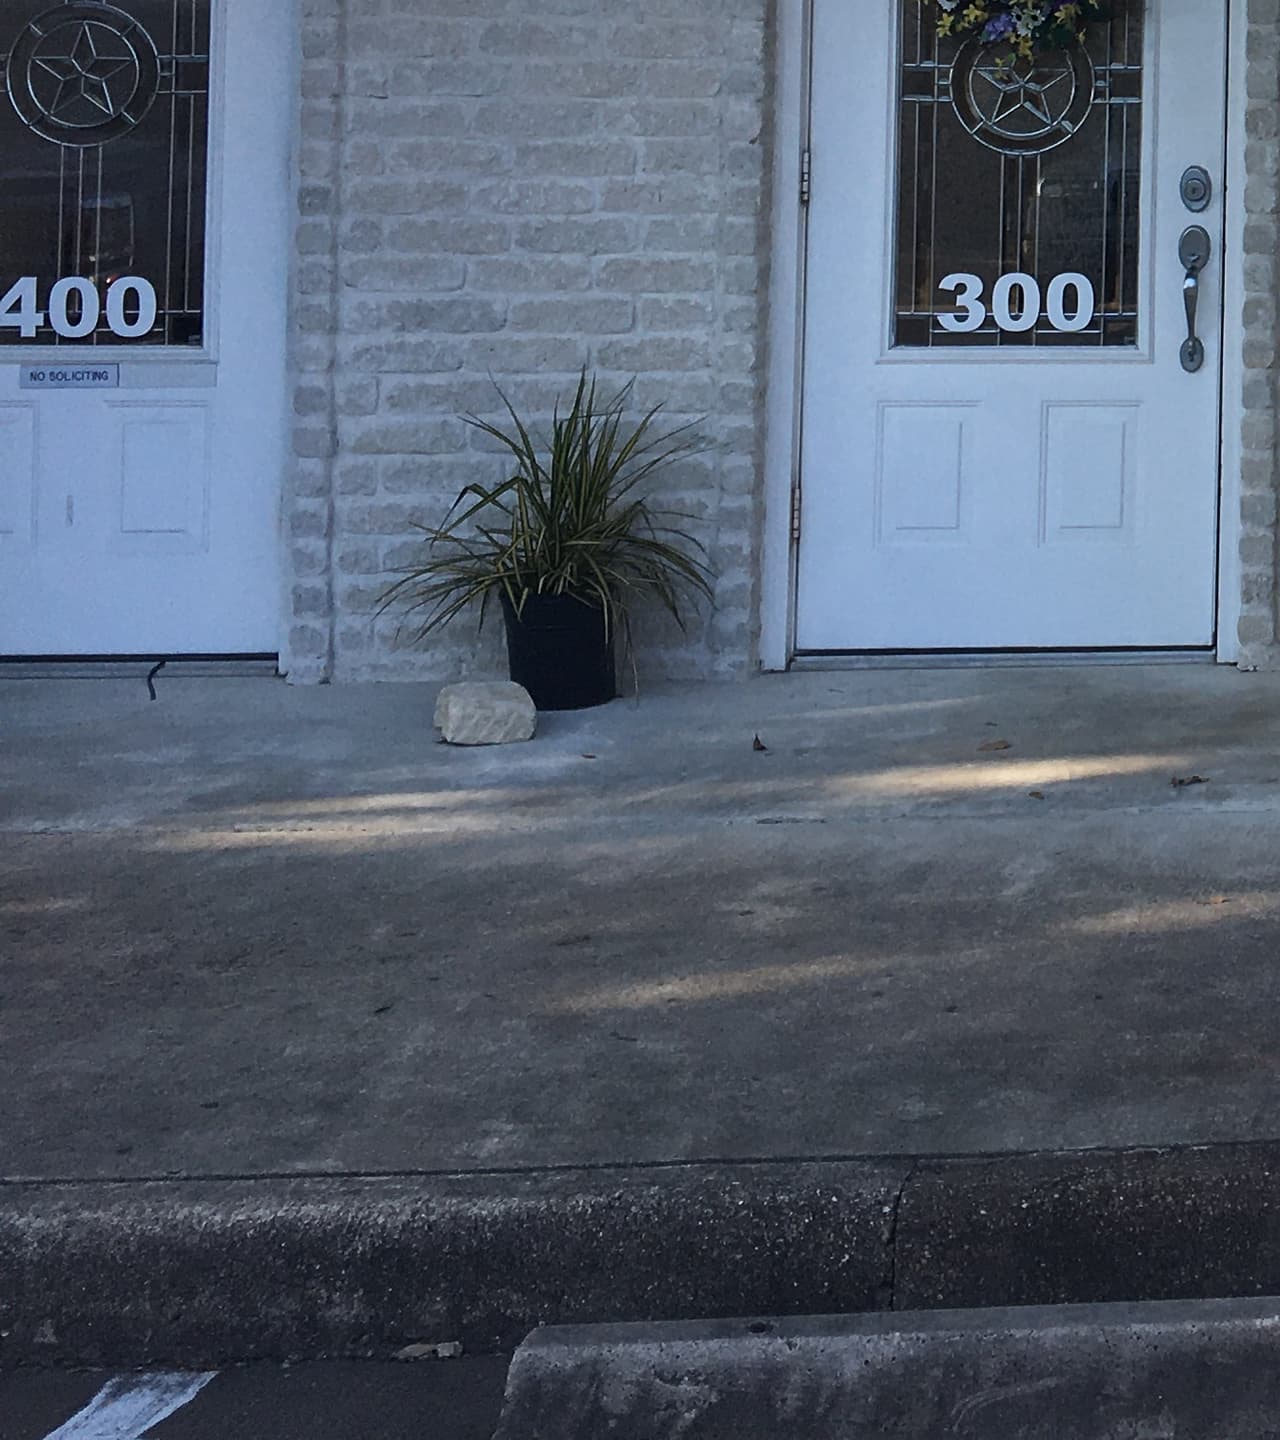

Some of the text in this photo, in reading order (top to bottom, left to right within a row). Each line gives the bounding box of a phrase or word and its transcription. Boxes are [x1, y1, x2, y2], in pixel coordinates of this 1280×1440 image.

[0, 276, 157, 338] 400
[936, 272, 1095, 333] 300
[30, 370, 109, 381] NO SOLICITING
